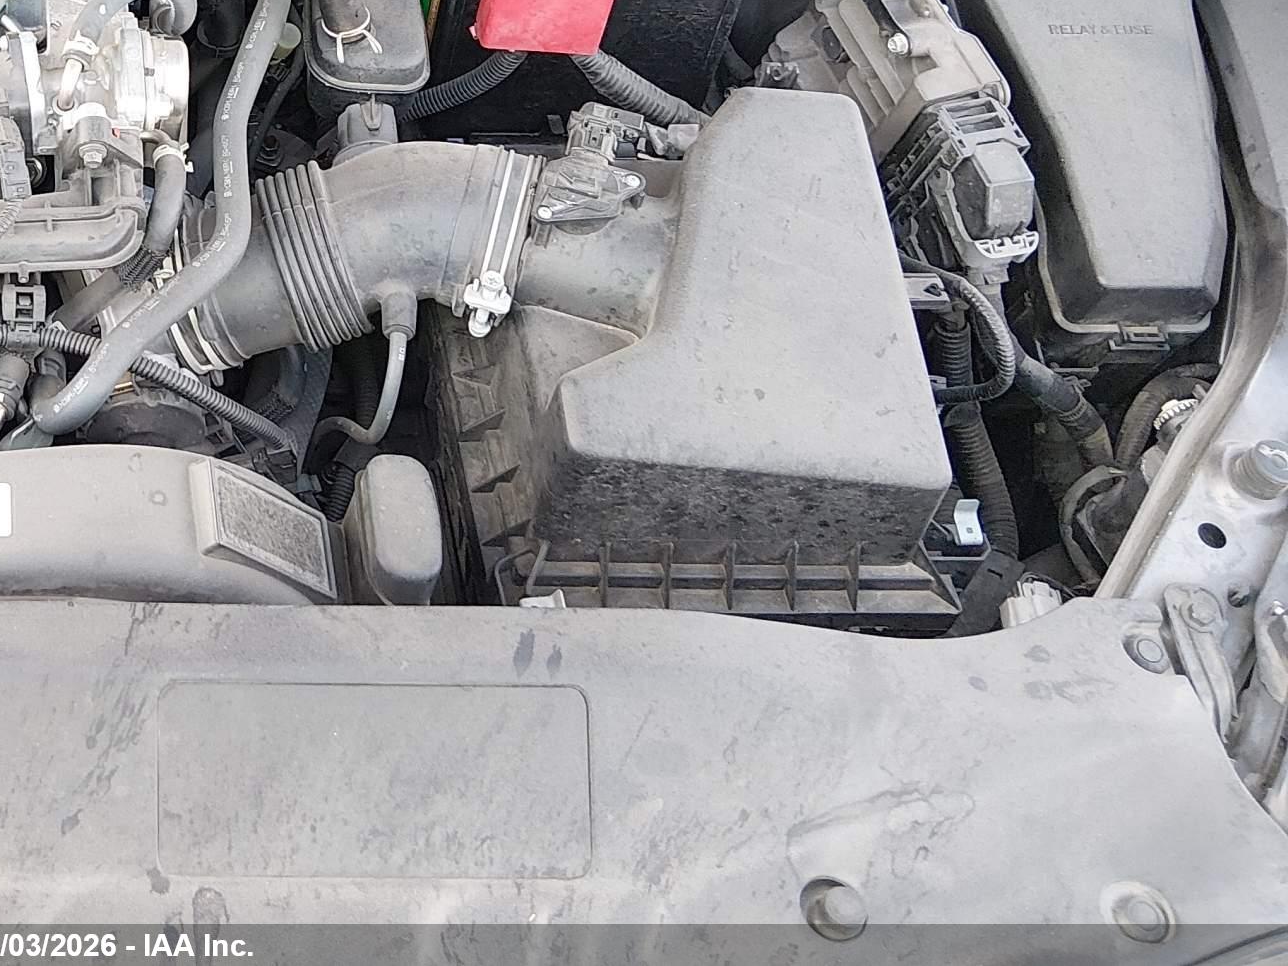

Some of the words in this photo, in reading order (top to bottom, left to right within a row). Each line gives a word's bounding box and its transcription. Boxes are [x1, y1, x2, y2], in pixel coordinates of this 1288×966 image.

[1048, 24, 1096, 35] RELAY
[1100, 24, 1110, 34] &
[1113, 24, 1153, 35] FUSE
